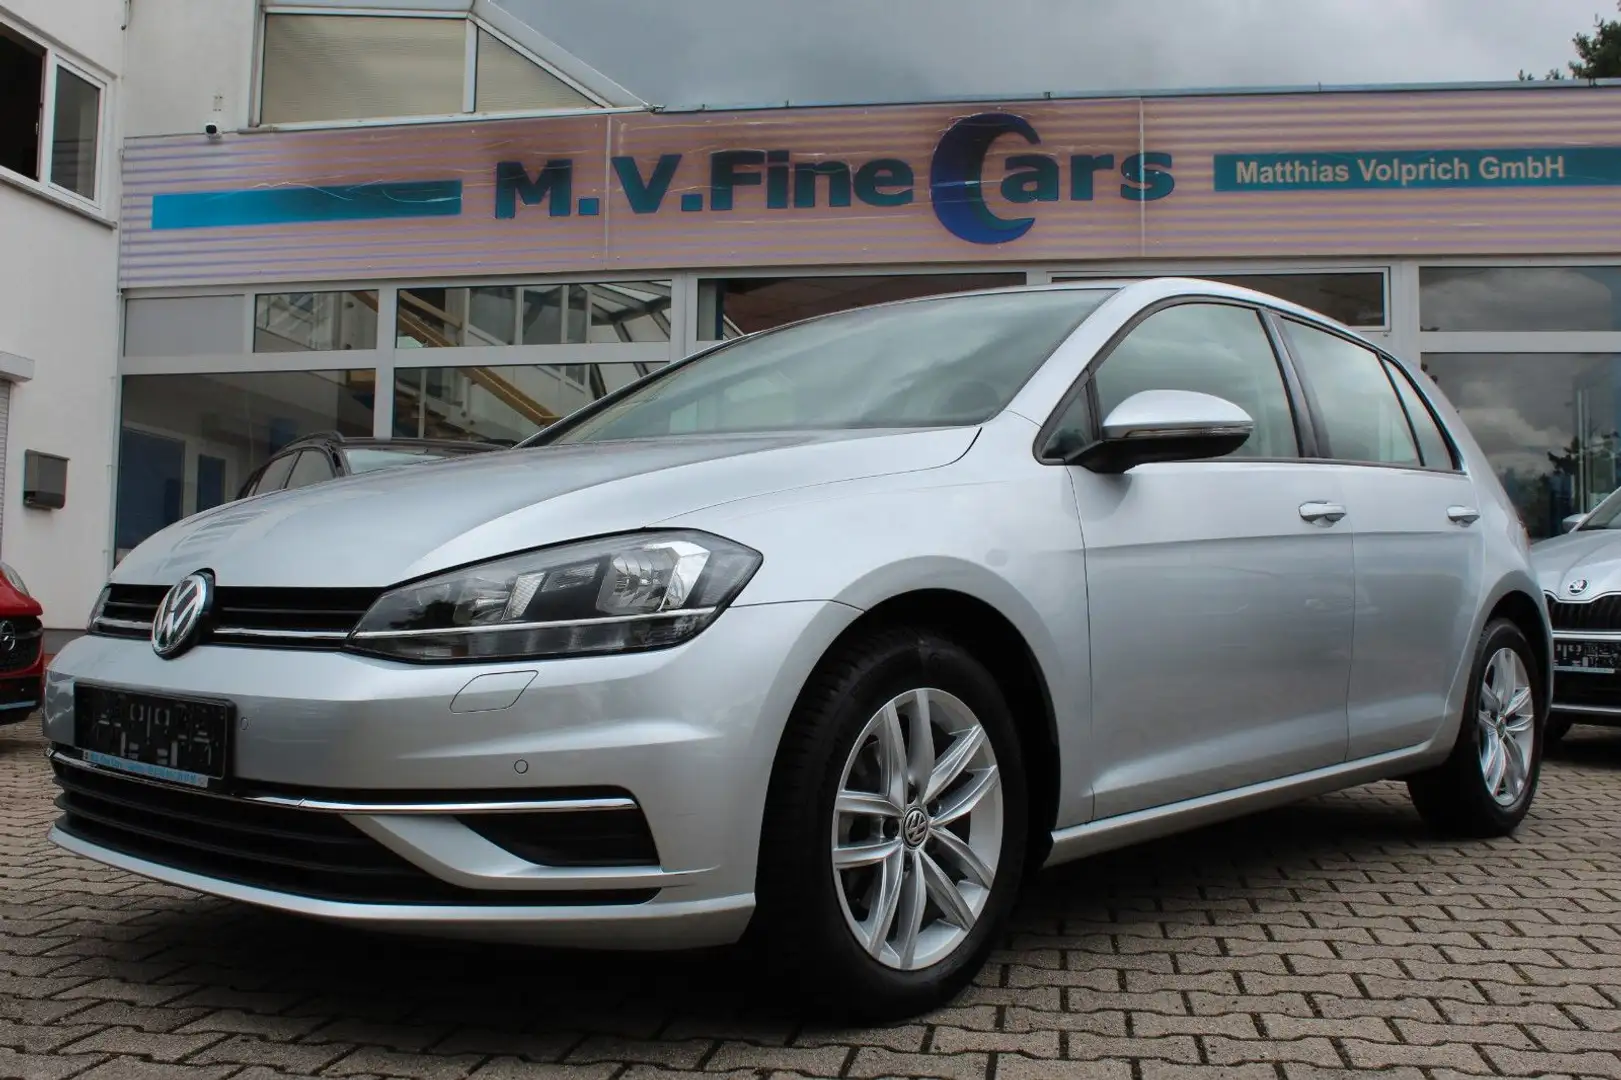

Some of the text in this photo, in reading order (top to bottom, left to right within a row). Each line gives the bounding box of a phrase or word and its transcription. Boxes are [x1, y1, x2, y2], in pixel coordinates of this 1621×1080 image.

[1235, 155, 1565, 185] Matthias Volprich GmbH
